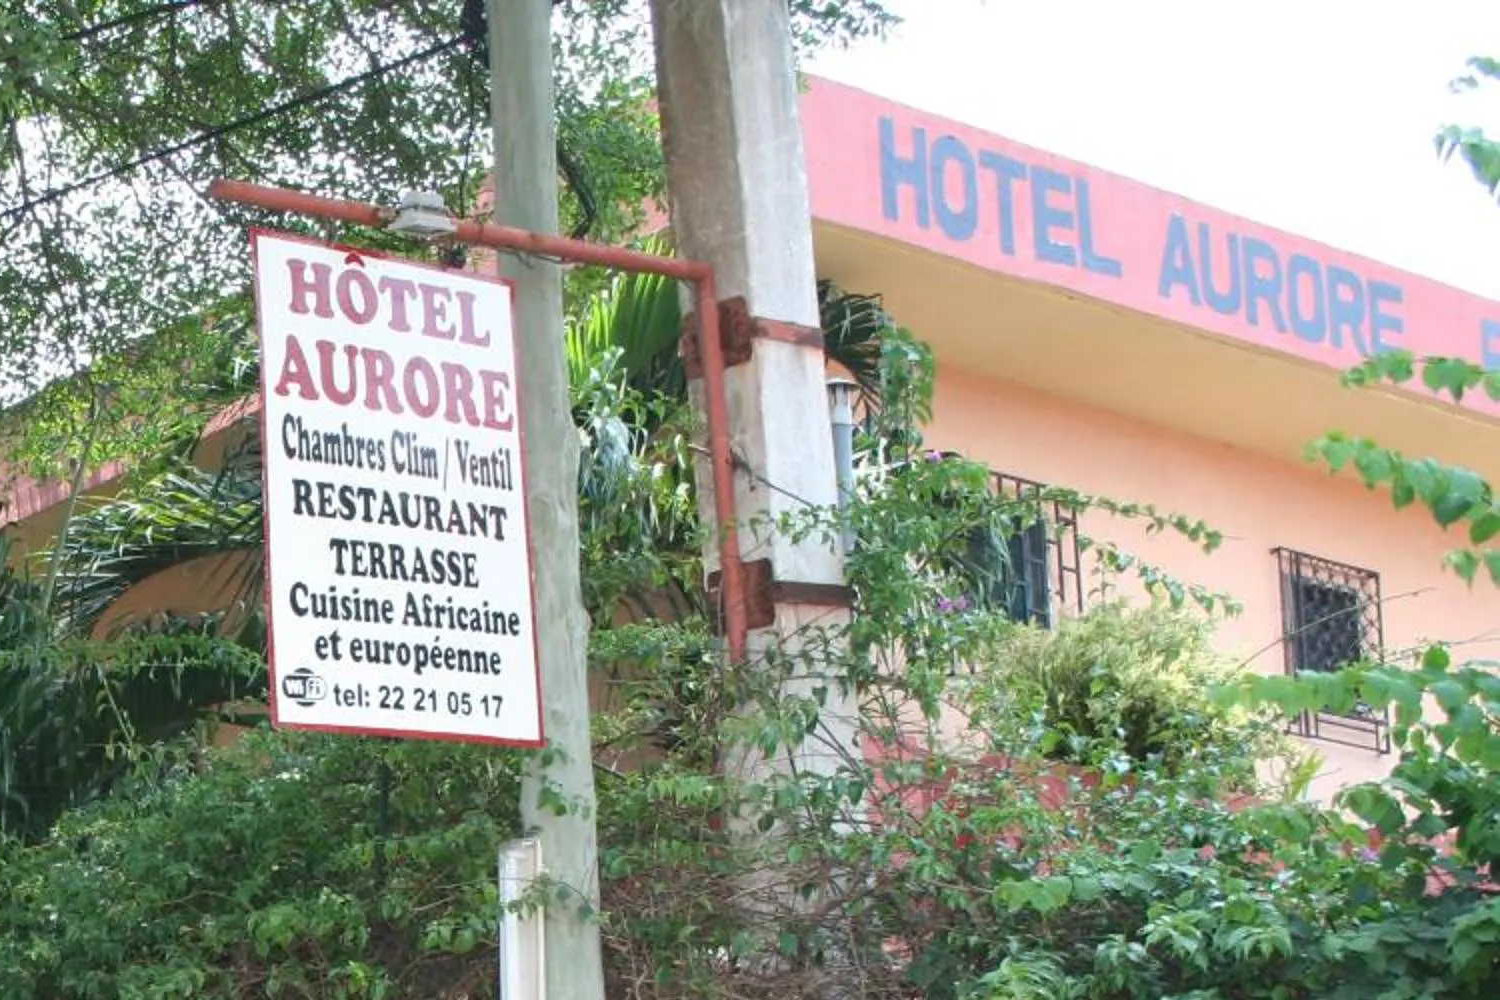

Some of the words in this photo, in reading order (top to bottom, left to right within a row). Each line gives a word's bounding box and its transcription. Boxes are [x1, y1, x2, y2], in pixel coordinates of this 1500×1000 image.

[878, 115, 1122, 278] HOTEL
[1158, 213, 1404, 355] AURORE
[286, 252, 491, 347] HÔTEL
[274, 334, 514, 432] AURORE
[282, 412, 386, 472] Chambres
[391, 429, 439, 479] Clim
[454, 438, 513, 491] Ventil
[292, 478, 508, 541] RESTAURANT
[329, 538, 480, 589] TERRASSE
[289, 581, 394, 624] Cuisine
[401, 591, 521, 636] Africaine
[314, 629, 343, 661] et
[349, 635, 501, 675] européenne
[378, 685, 405, 711] 22
[413, 687, 437, 713] 21
[447, 691, 472, 717] 05
[479, 695, 503, 719] 17
